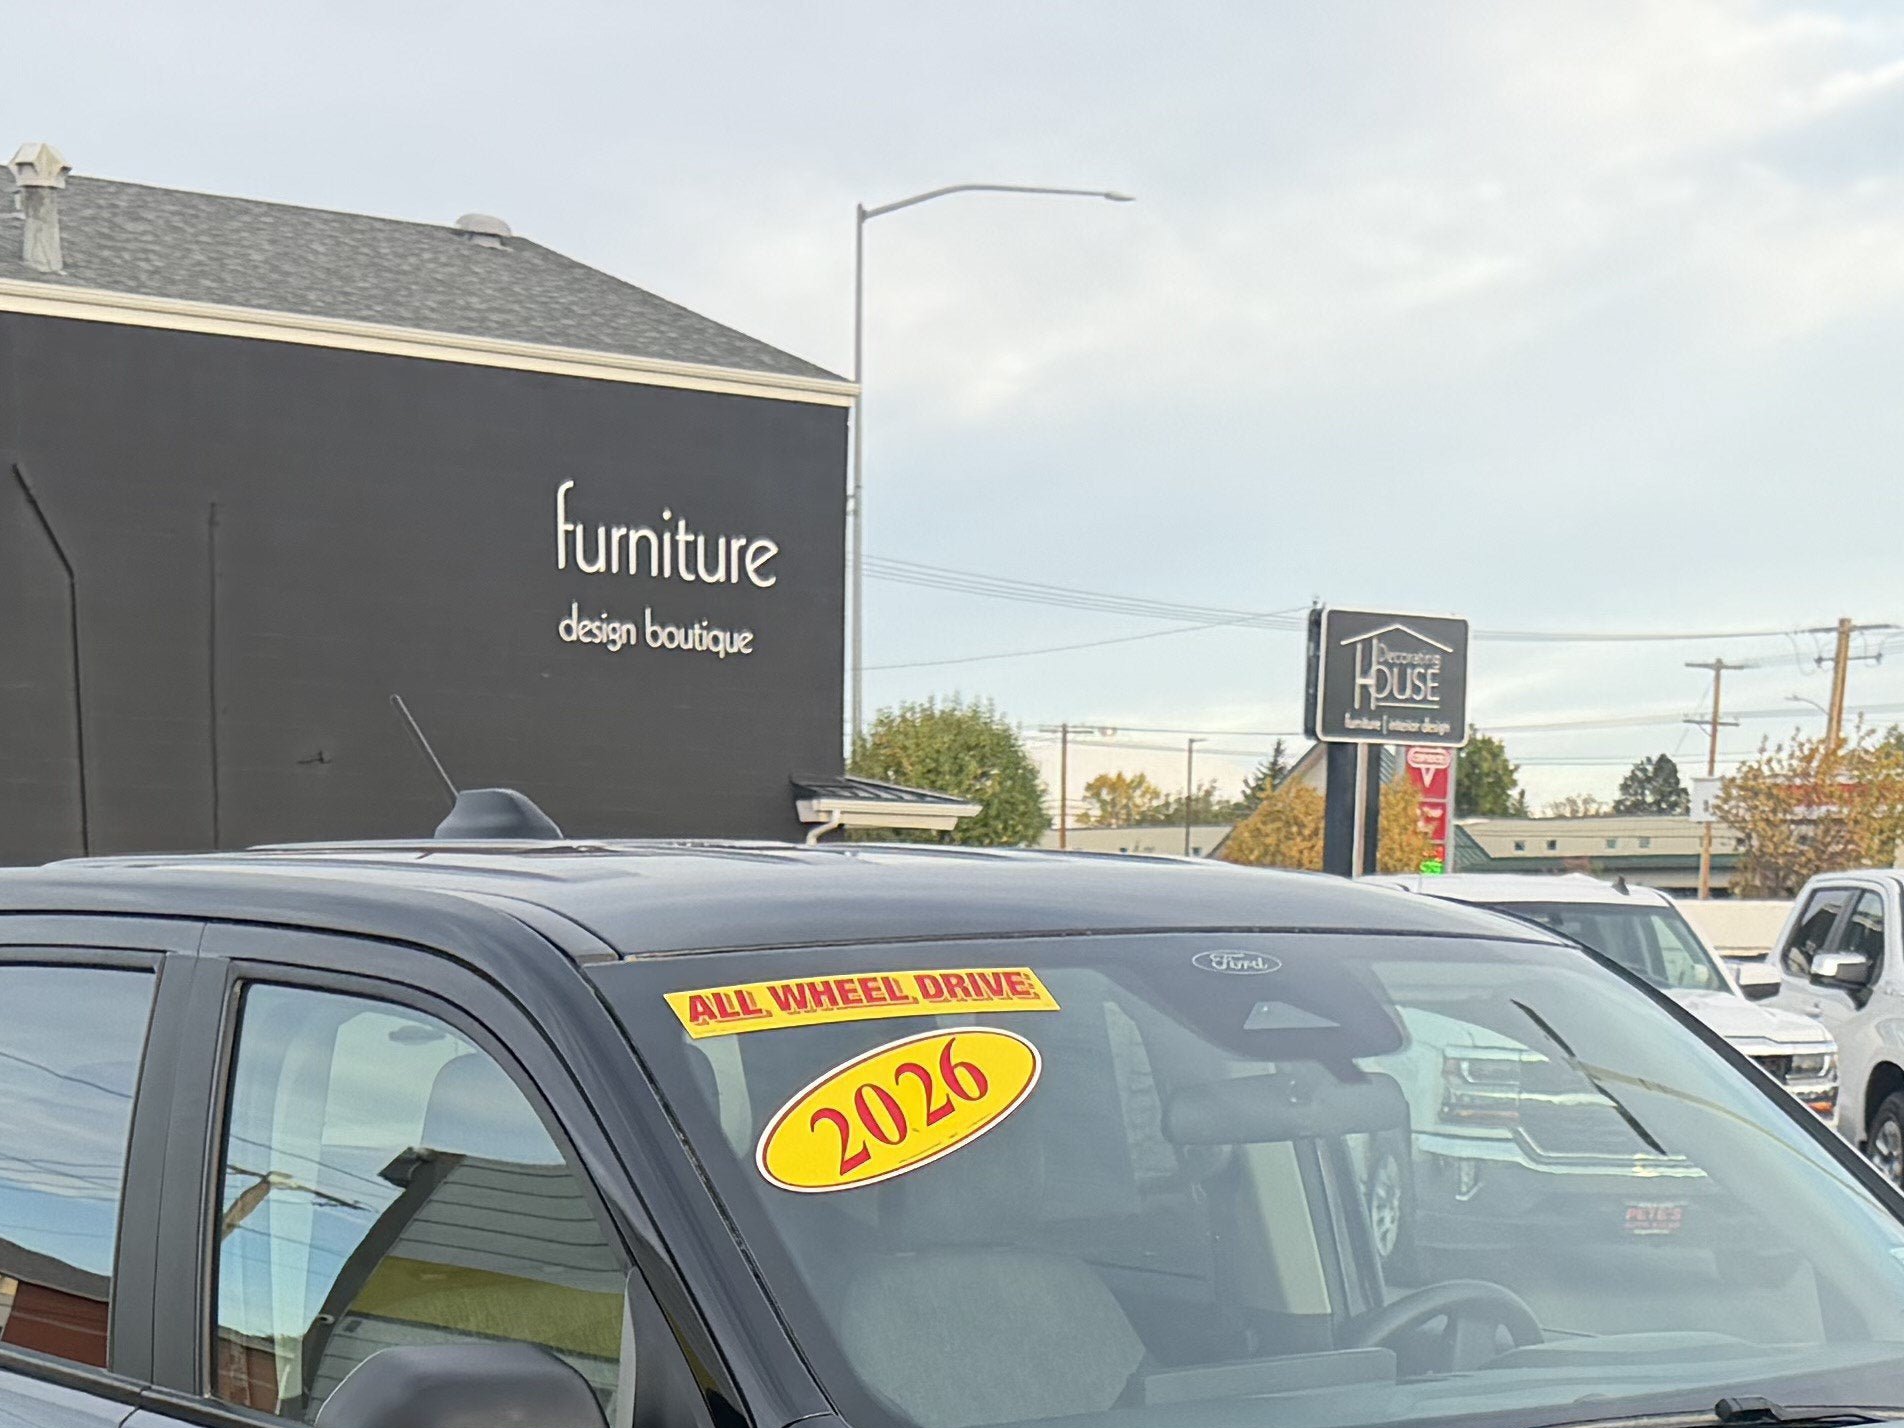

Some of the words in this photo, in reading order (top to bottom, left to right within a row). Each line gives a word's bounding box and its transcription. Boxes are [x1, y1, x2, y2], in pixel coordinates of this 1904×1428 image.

[555, 478, 780, 588] furniture
[558, 601, 637, 652] design
[644, 607, 754, 659] boutique
[1354, 636, 1441, 710] HOUSE
[1209, 952, 1268, 970] Ford
[688, 988, 766, 1024] ALL
[768, 976, 913, 1013] WHEEL
[915, 971, 1034, 1002] DRIVE
[809, 1037, 989, 1177] 2026
